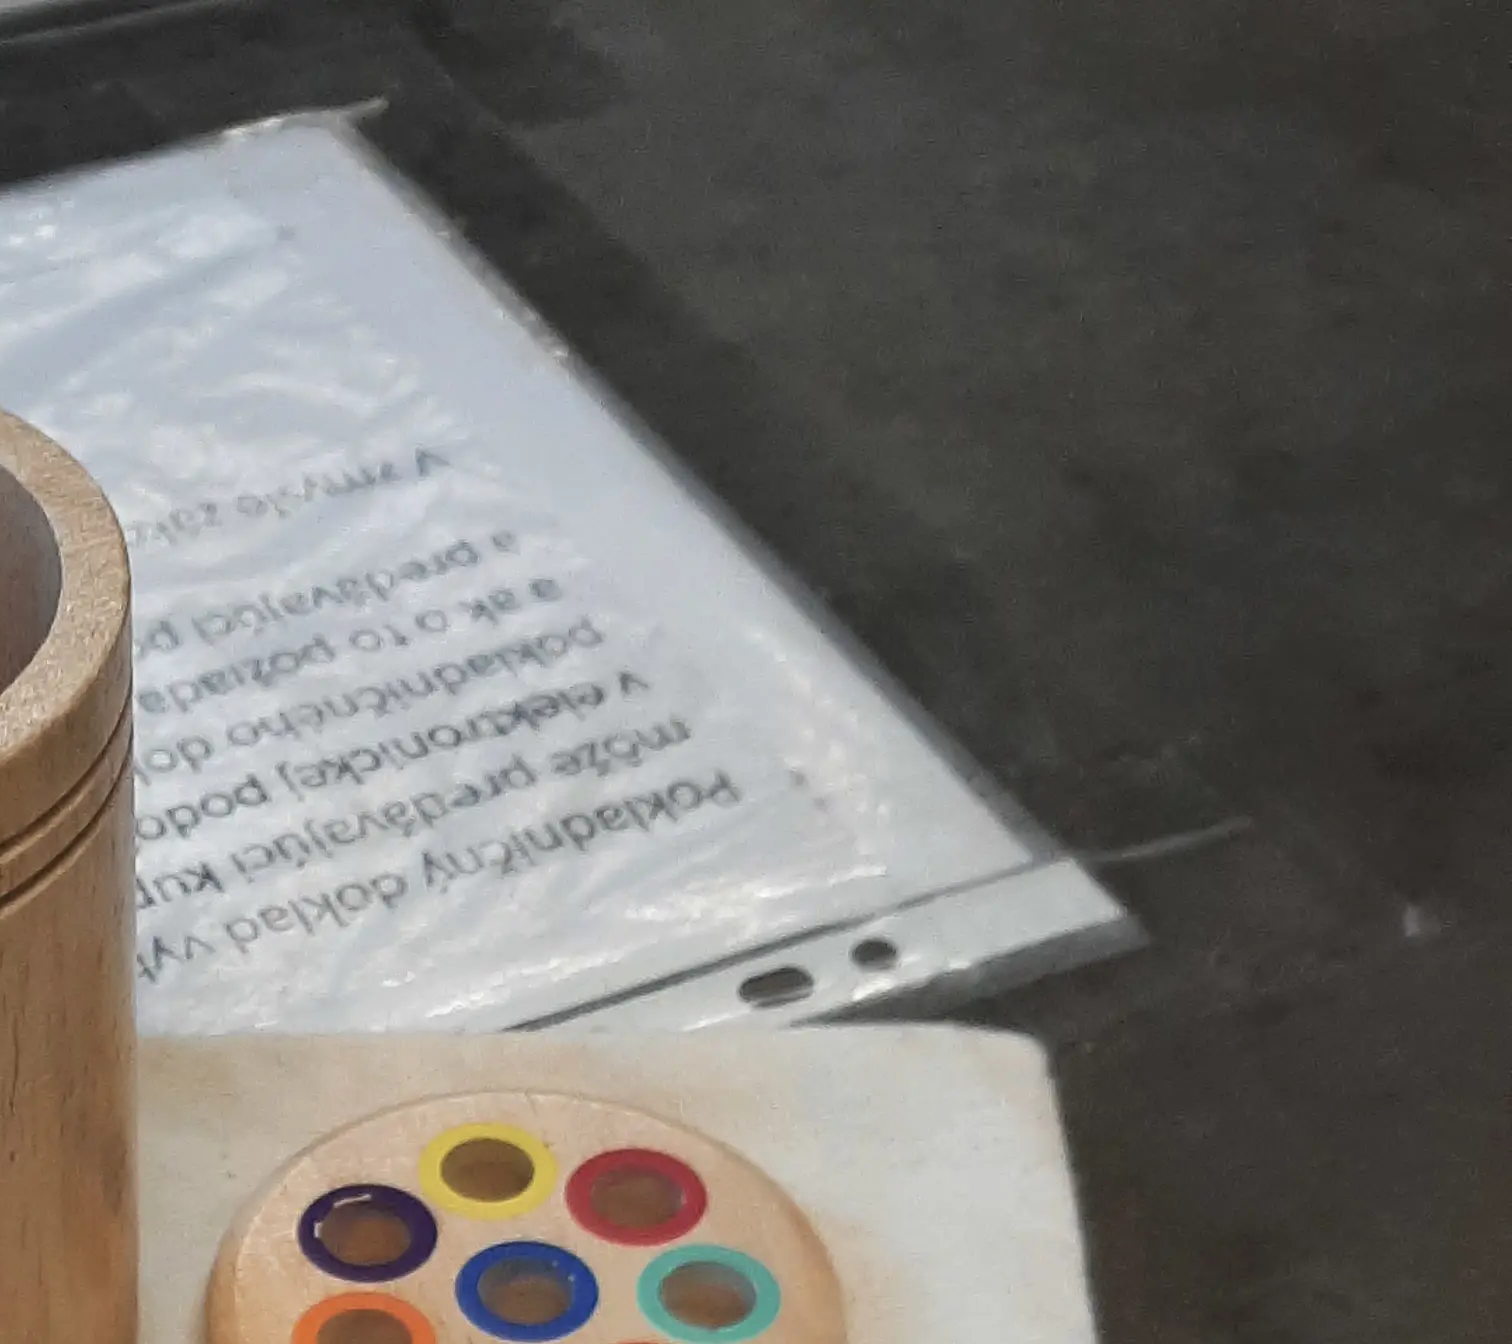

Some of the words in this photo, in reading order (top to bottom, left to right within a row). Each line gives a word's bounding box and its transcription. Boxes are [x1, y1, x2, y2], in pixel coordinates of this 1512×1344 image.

[225, 615, 603, 749] pokladničného
[274, 683, 605, 801] elektronickej
[230, 753, 535, 883] predávajúci
[421, 768, 739, 897] Pokladničný
[224, 873, 407, 956] doklad
